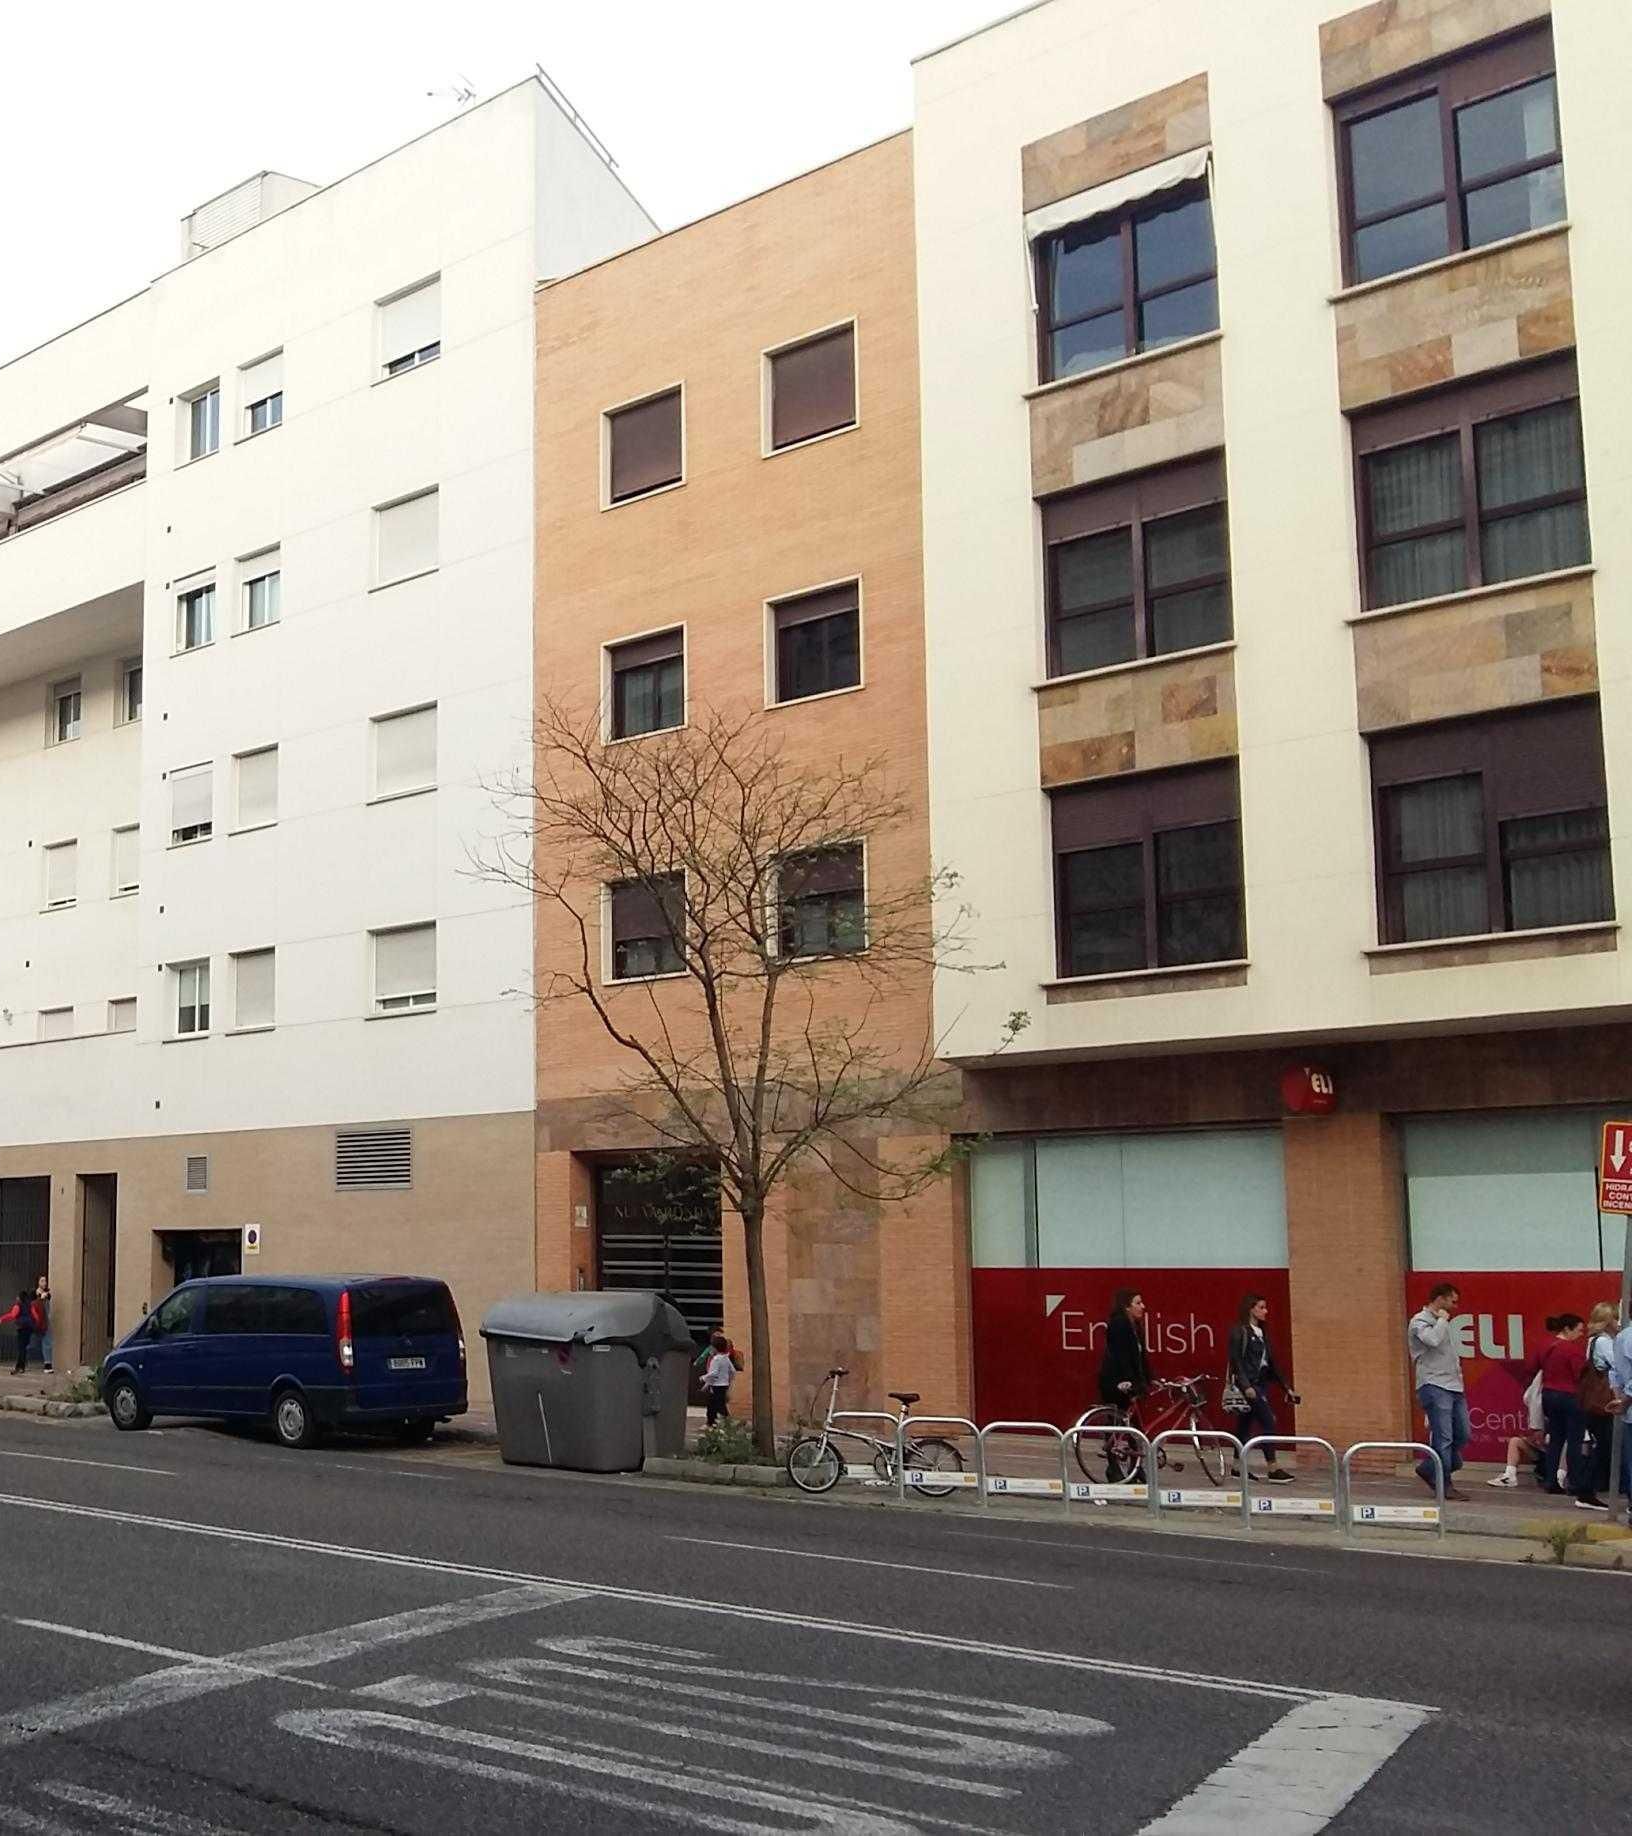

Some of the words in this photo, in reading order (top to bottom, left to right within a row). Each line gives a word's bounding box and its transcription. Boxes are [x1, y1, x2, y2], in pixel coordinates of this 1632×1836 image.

[1311, 1073, 1333, 1094] ELI
[1061, 1311, 1215, 1354] Enlish
[1468, 1407, 1530, 1431] Cent
